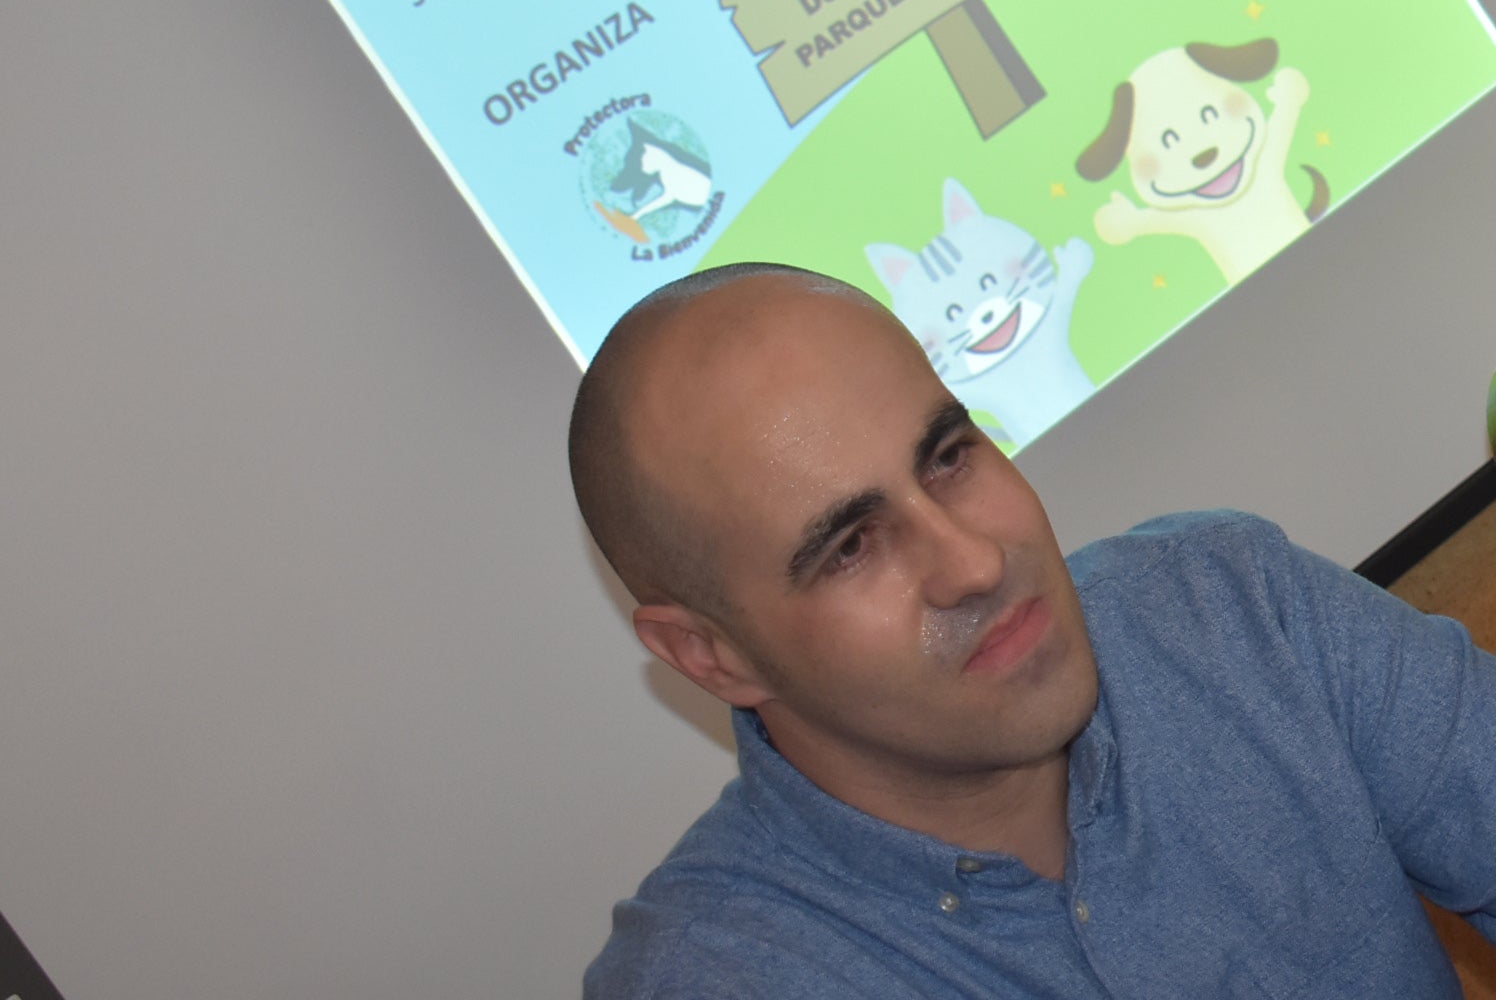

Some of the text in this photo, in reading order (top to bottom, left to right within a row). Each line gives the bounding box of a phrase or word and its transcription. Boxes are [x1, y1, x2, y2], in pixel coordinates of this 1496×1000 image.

[482, 0, 655, 126] ORGANIZA
[563, 93, 652, 157] Protectora
[631, 191, 726, 262] La Bienvenida
